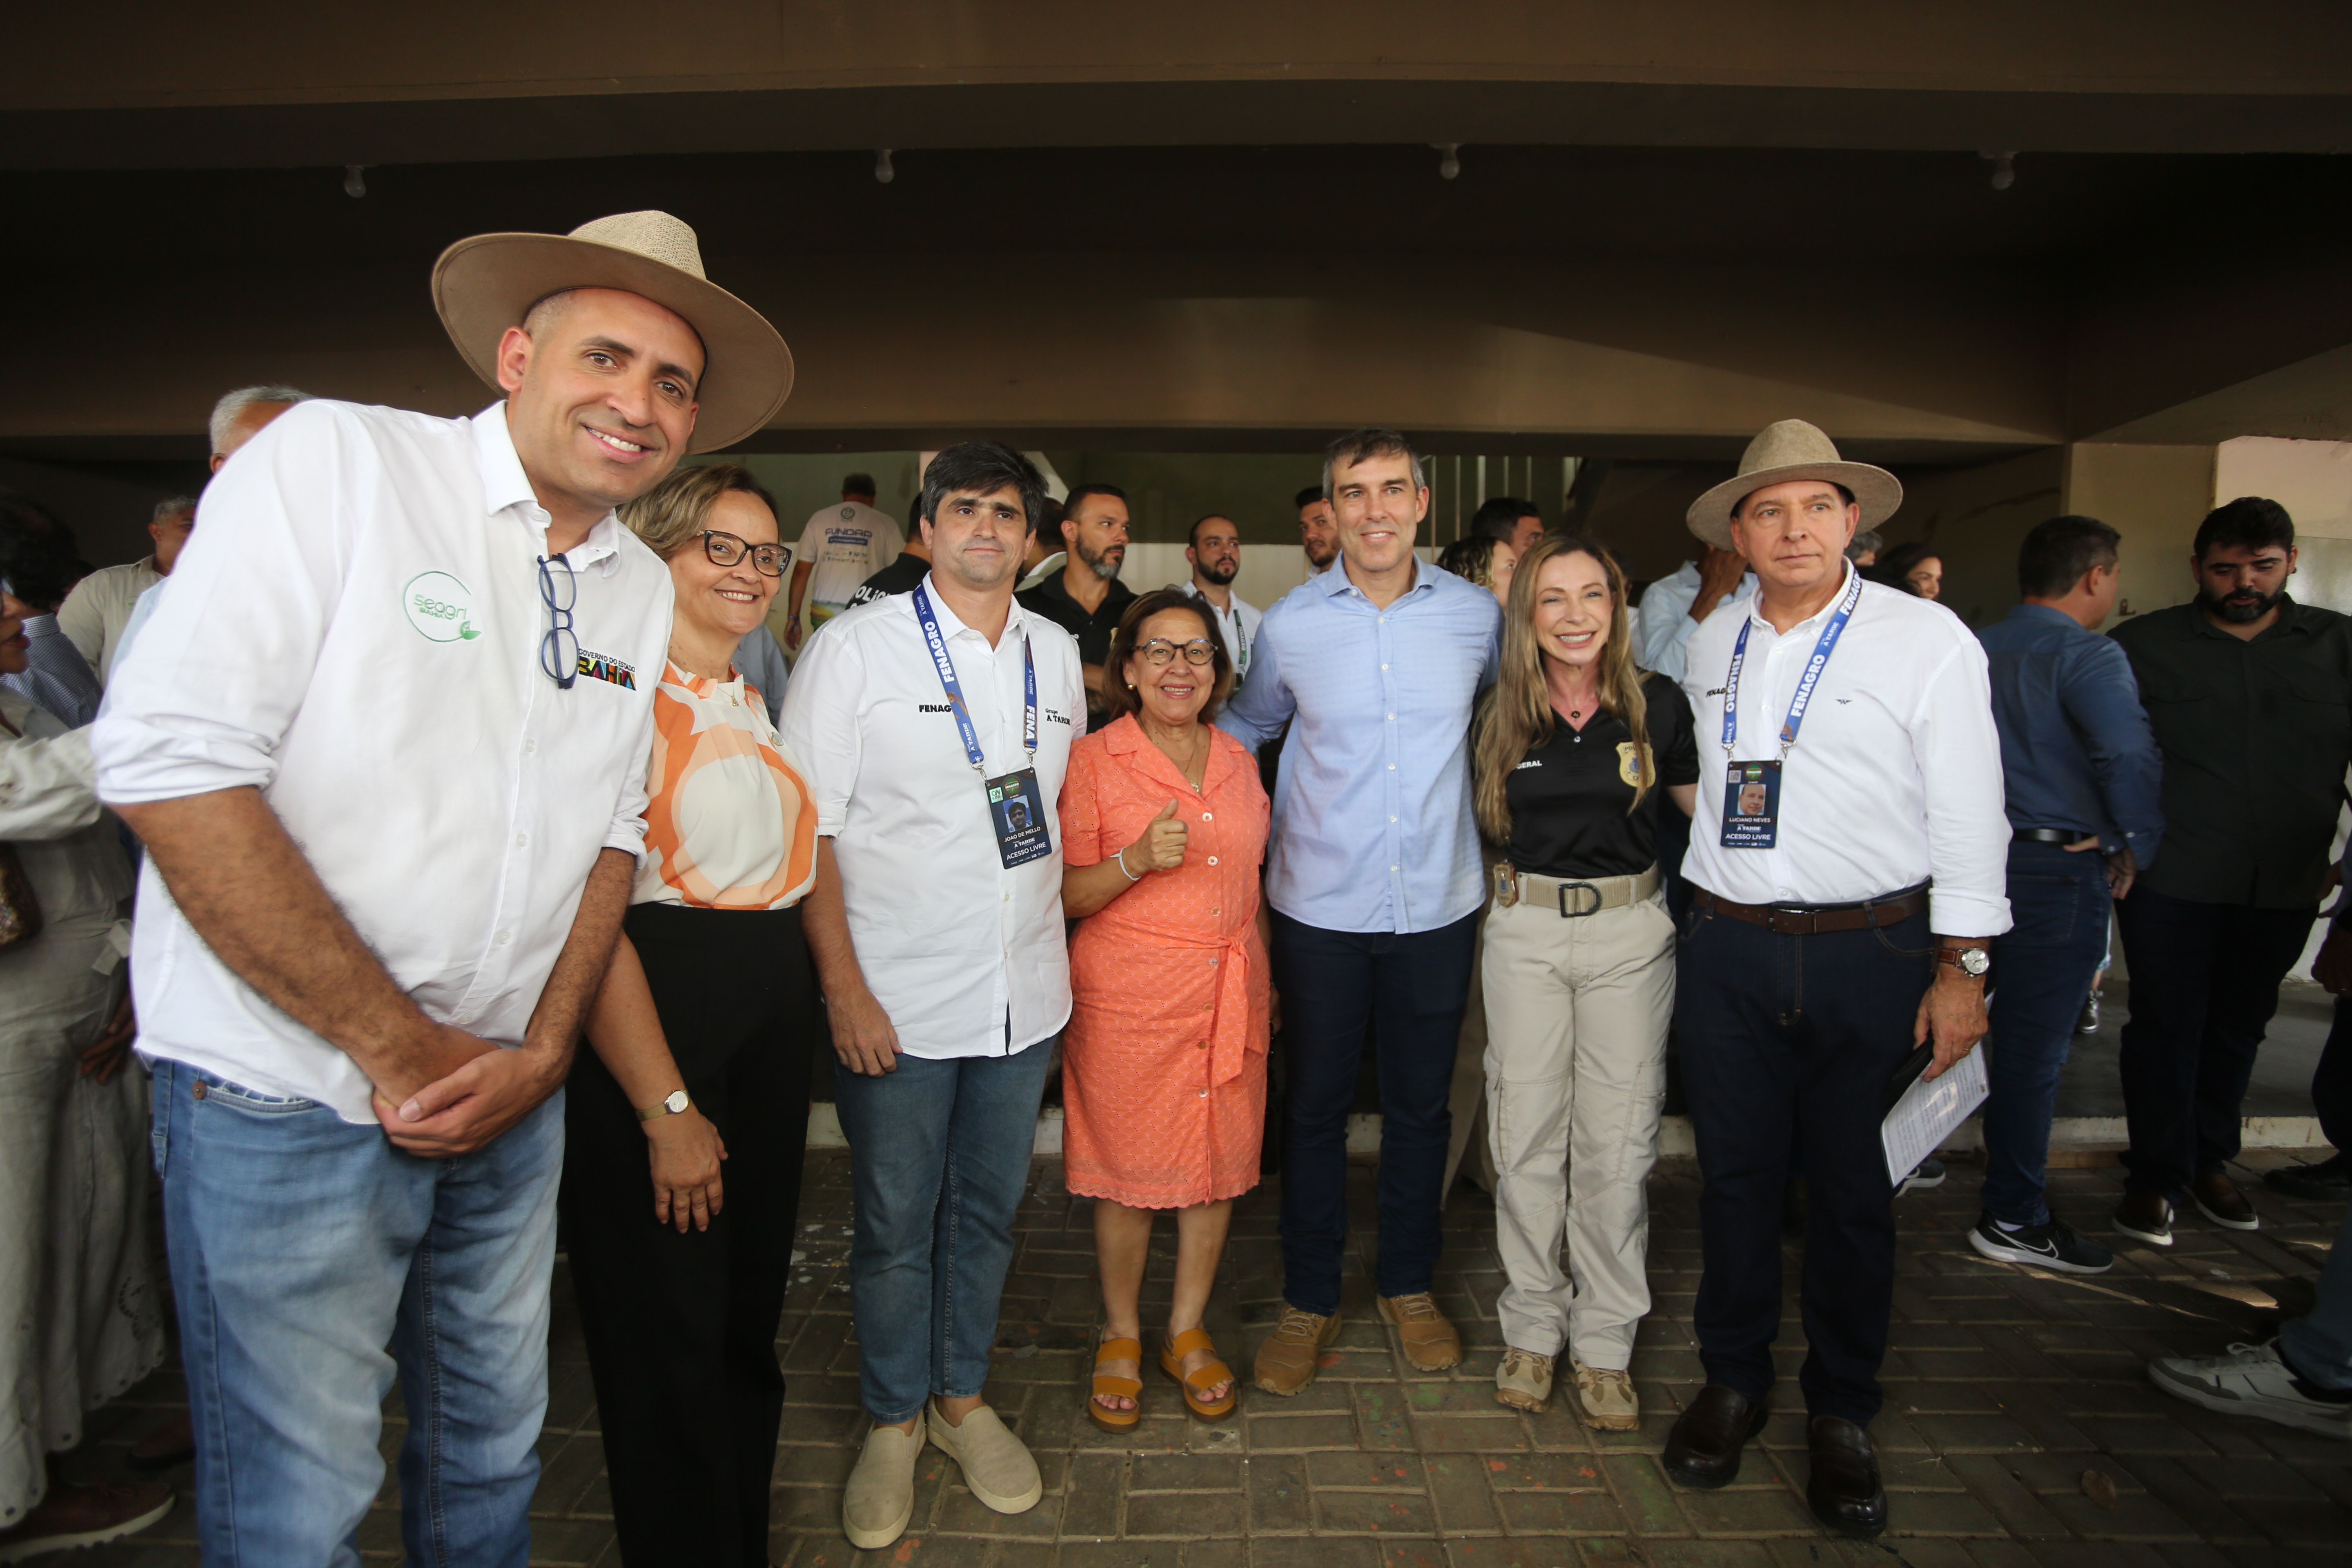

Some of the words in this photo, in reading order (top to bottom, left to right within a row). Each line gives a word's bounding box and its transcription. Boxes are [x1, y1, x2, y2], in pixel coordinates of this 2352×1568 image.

[1839, 570, 1861, 616] FENAGR
[579, 648, 608, 662] GOVERNO
[618, 660, 635, 672] ESTADO
[924, 621, 955, 683] FENAGRO
[1725, 653, 1743, 713] FENAGRO
[1790, 654, 1825, 717] FENAGRO
[962, 723, 973, 745] TARDE
[1018, 837, 1035, 846] TARDE
[1025, 826, 1040, 835] MELLO
[1007, 848, 1029, 860] ACESSO
[1030, 842, 1046, 852] LIVRE
